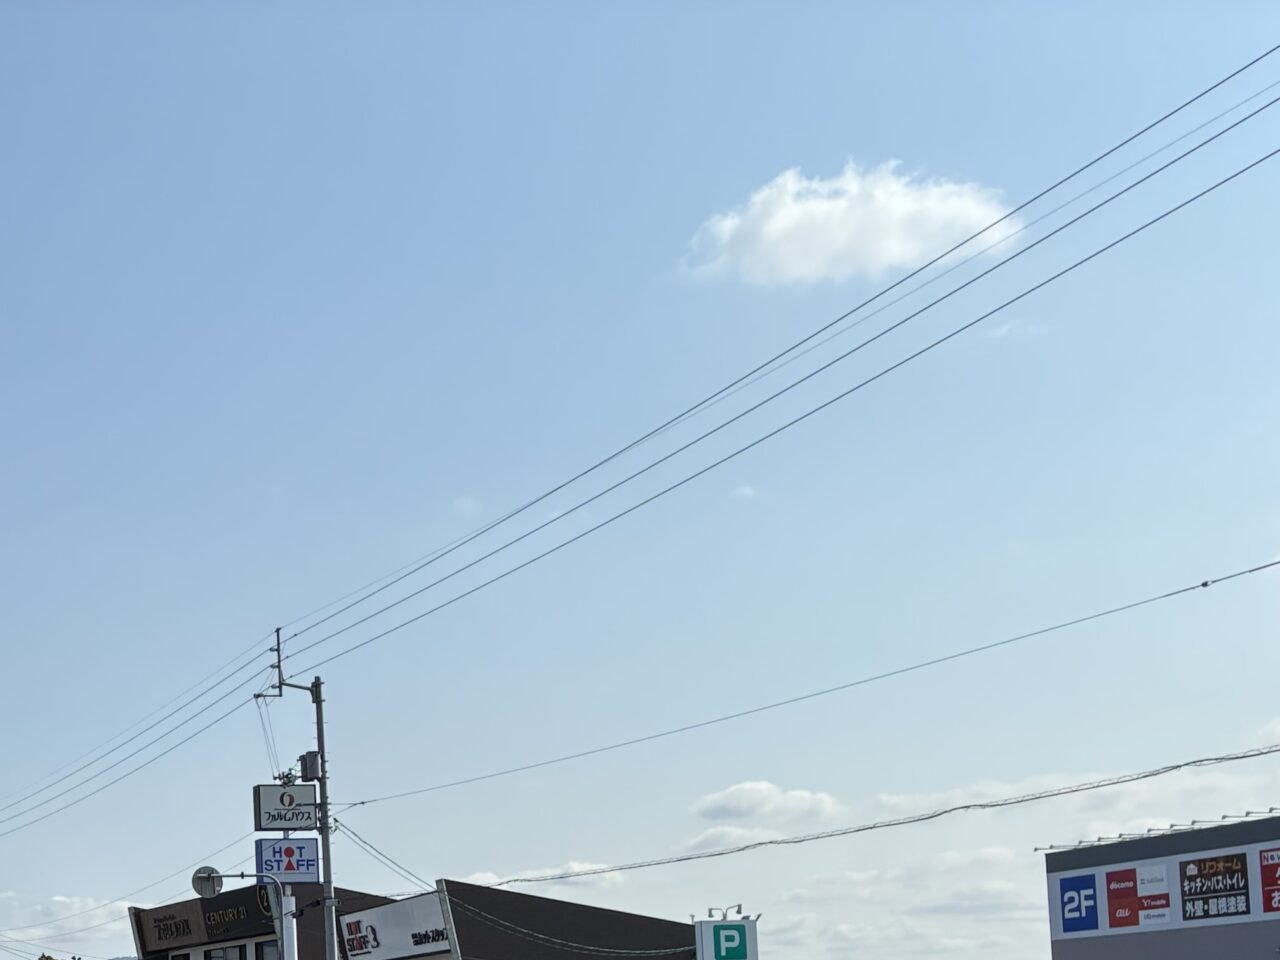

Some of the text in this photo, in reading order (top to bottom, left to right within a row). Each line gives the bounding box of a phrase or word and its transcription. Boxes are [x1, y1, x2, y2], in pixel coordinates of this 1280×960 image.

[272, 846, 306, 859] HOT
[264, 859, 316, 872] STAFF
[1201, 857, 1242, 874] リフォーム
[1064, 888, 1095, 919] 2F
[720, 929, 740, 956] P
